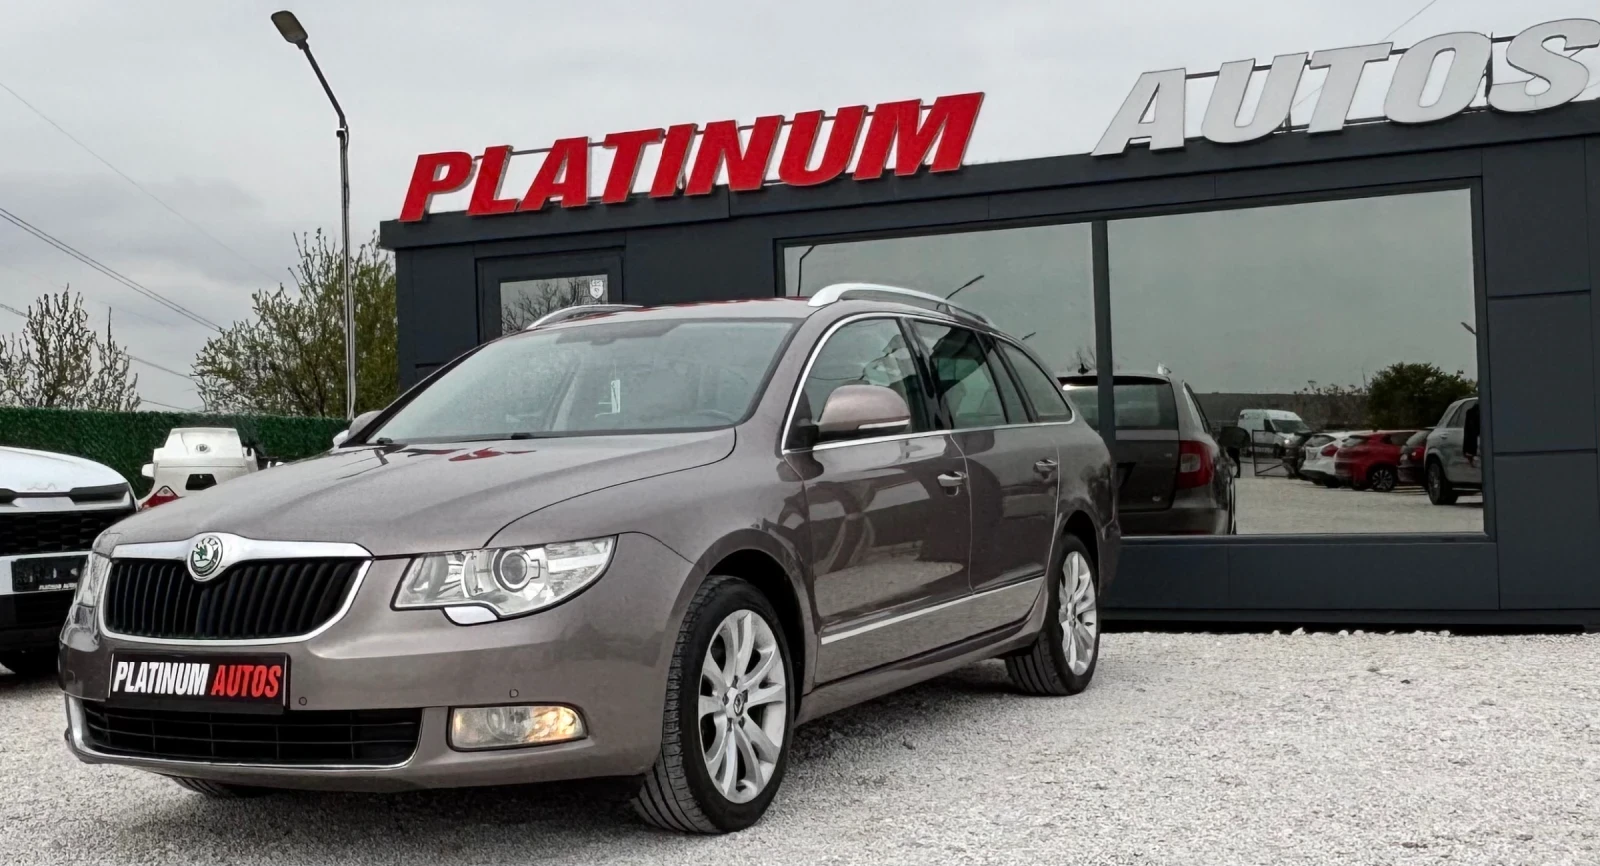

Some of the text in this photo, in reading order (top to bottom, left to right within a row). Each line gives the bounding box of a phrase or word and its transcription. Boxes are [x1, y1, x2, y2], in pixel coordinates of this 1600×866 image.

[399, 18, 1600, 222] PLATINUM AUTOS
[112, 661, 282, 698] PLATINUM AUTOS
